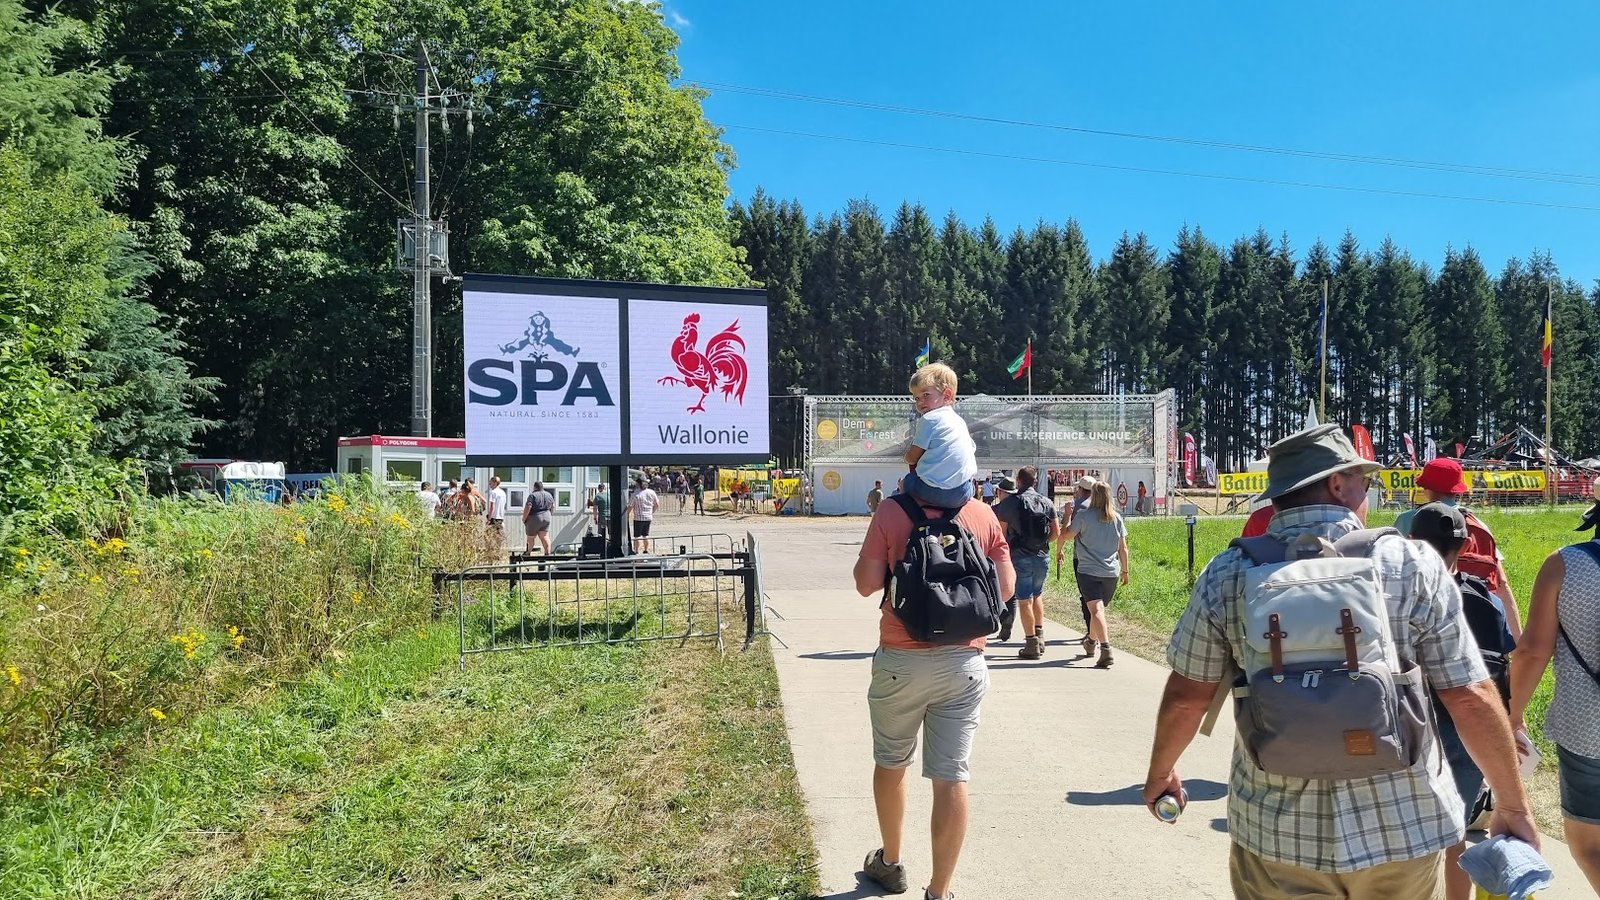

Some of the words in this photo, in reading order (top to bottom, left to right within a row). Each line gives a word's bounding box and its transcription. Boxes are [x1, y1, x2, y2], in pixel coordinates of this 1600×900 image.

[658, 424, 749, 445] Wallonie
[860, 429, 896, 439] Forest
[990, 431, 1013, 440] UNE
[1016, 429, 1085, 440] EXPÉRIENCE
[1089, 431, 1131, 441] UNIQUE
